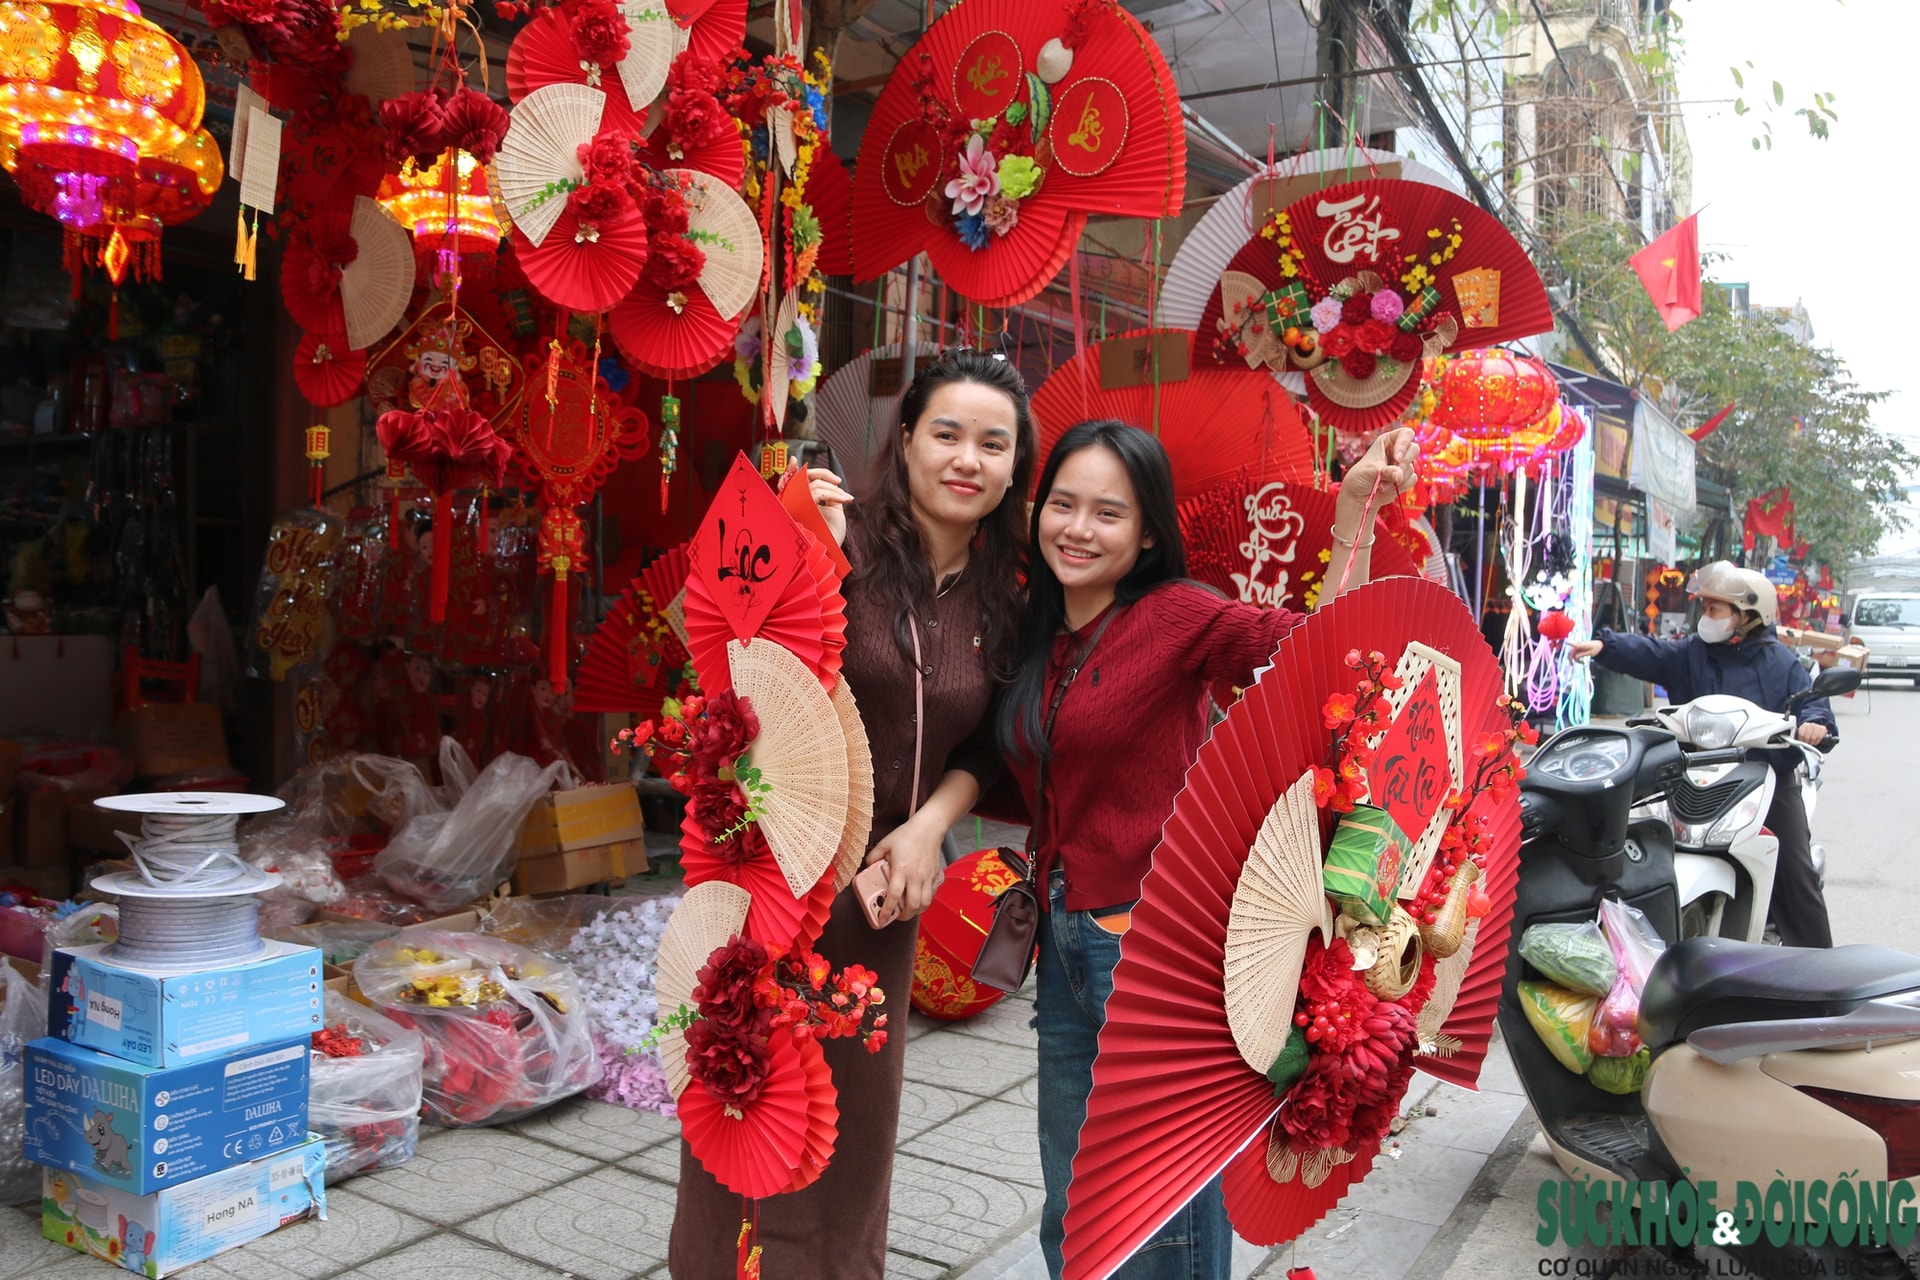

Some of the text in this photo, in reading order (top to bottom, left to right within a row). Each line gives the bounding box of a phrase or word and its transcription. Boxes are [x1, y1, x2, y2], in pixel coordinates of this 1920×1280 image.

[1316, 193, 1400, 263] Tết
[1244, 482, 1304, 539] Xuân
[718, 518, 778, 583] Lộc
[1406, 699, 1435, 752] Xuân
[89, 999, 120, 1020] Hong NA
[137, 1043, 152, 1054] LED
[34, 1067, 56, 1087] LED
[57, 1074, 80, 1095] DÂY
[81, 1075, 140, 1113] DALUHA
[245, 1100, 282, 1121] DALUHA
[207, 1197, 255, 1224] Hong NA
